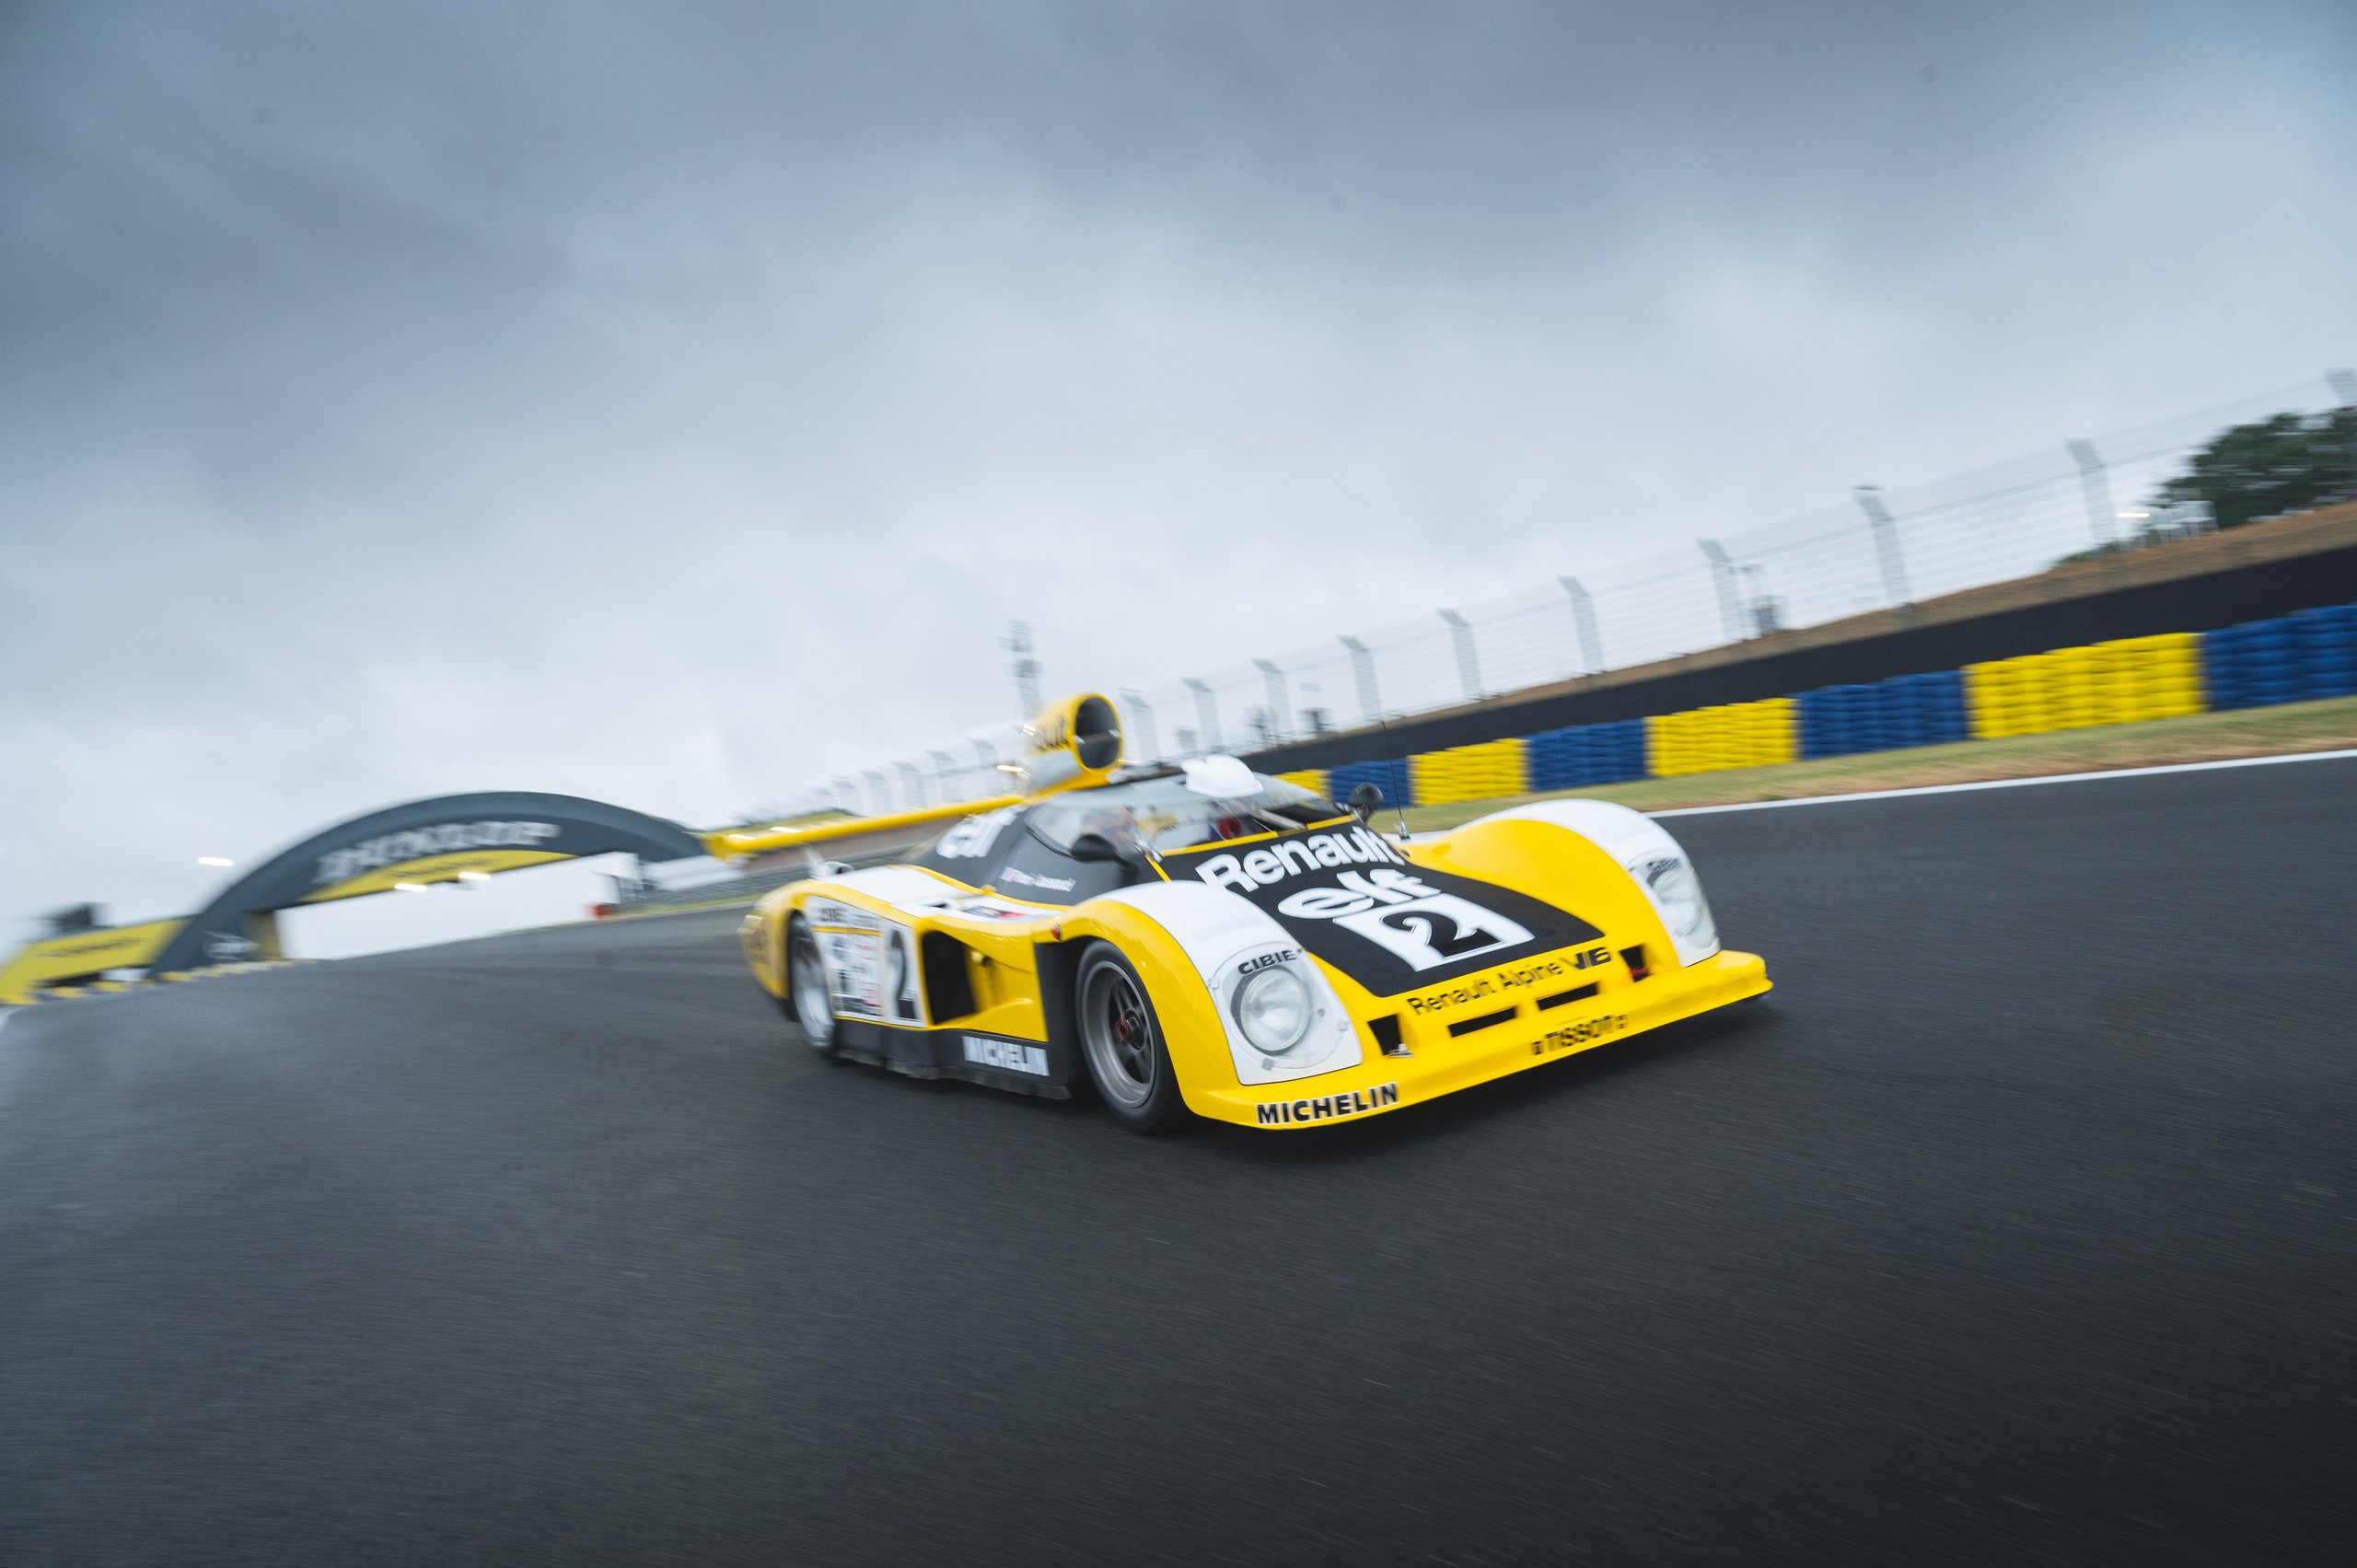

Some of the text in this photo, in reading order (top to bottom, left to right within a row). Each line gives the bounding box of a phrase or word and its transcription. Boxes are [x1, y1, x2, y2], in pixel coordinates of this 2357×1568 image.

[1194, 825, 1405, 893] Renault
[1277, 868, 1442, 919] elf
[1379, 911, 1500, 958] 2
[1237, 949, 1298, 975] CIBIE
[1406, 979, 1496, 1015] Renault
[1497, 961, 1564, 989] Alpine
[1544, 1015, 1613, 1051] TISSOT
[962, 1036, 1050, 1076] MICHELIN
[1257, 1082, 1399, 1124] MICHELIN
